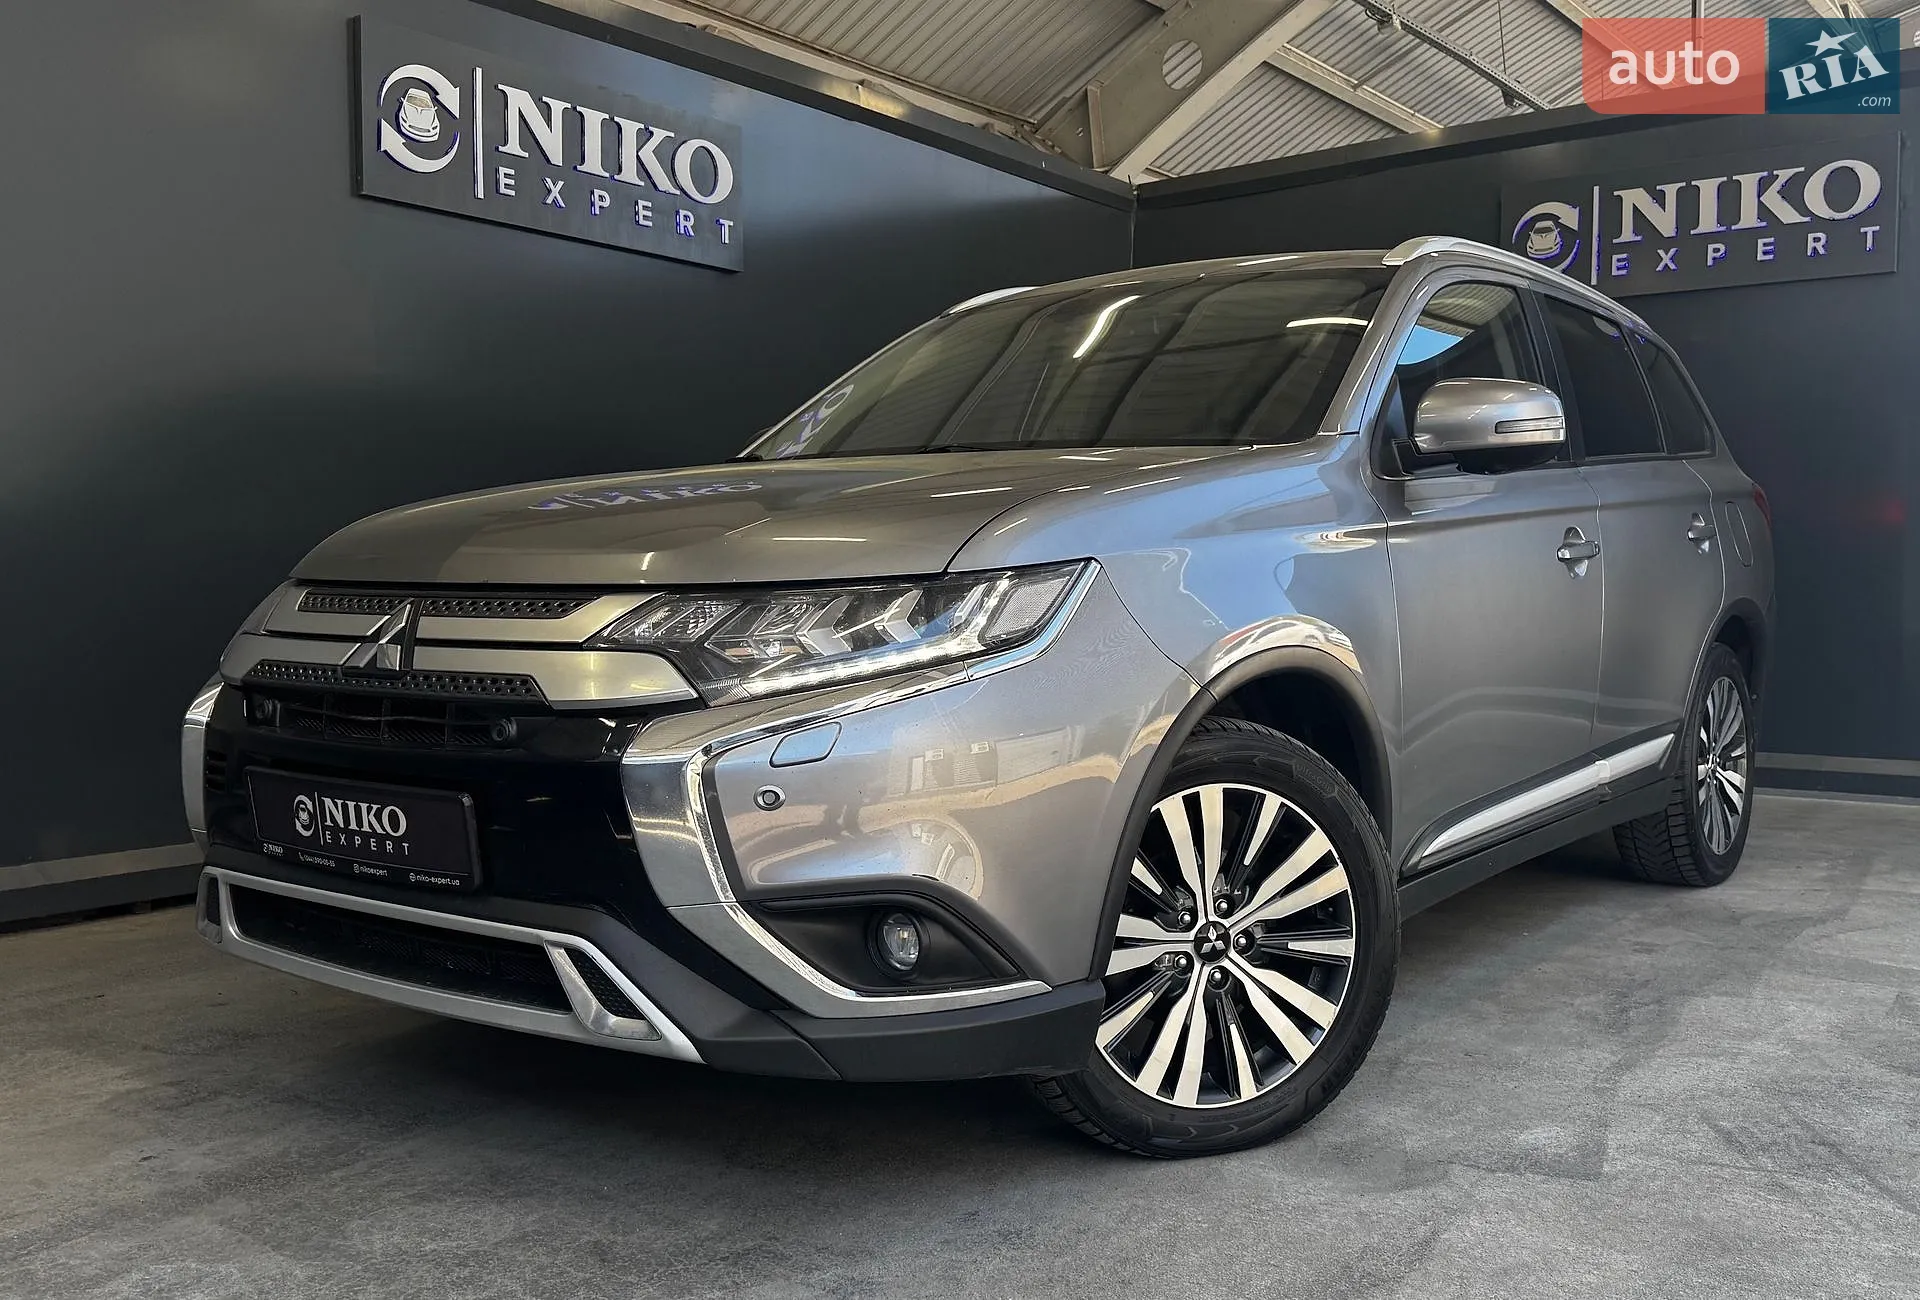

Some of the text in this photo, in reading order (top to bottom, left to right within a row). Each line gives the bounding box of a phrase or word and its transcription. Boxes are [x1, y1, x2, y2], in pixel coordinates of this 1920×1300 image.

[495, 83, 734, 205] NIKO
[495, 166, 734, 245] EXPERT
[1612, 159, 1882, 244] NIKO
[1611, 226, 1880, 276] EXPERT
[321, 796, 407, 837] NIKO
[326, 831, 409, 856] EXPERT
